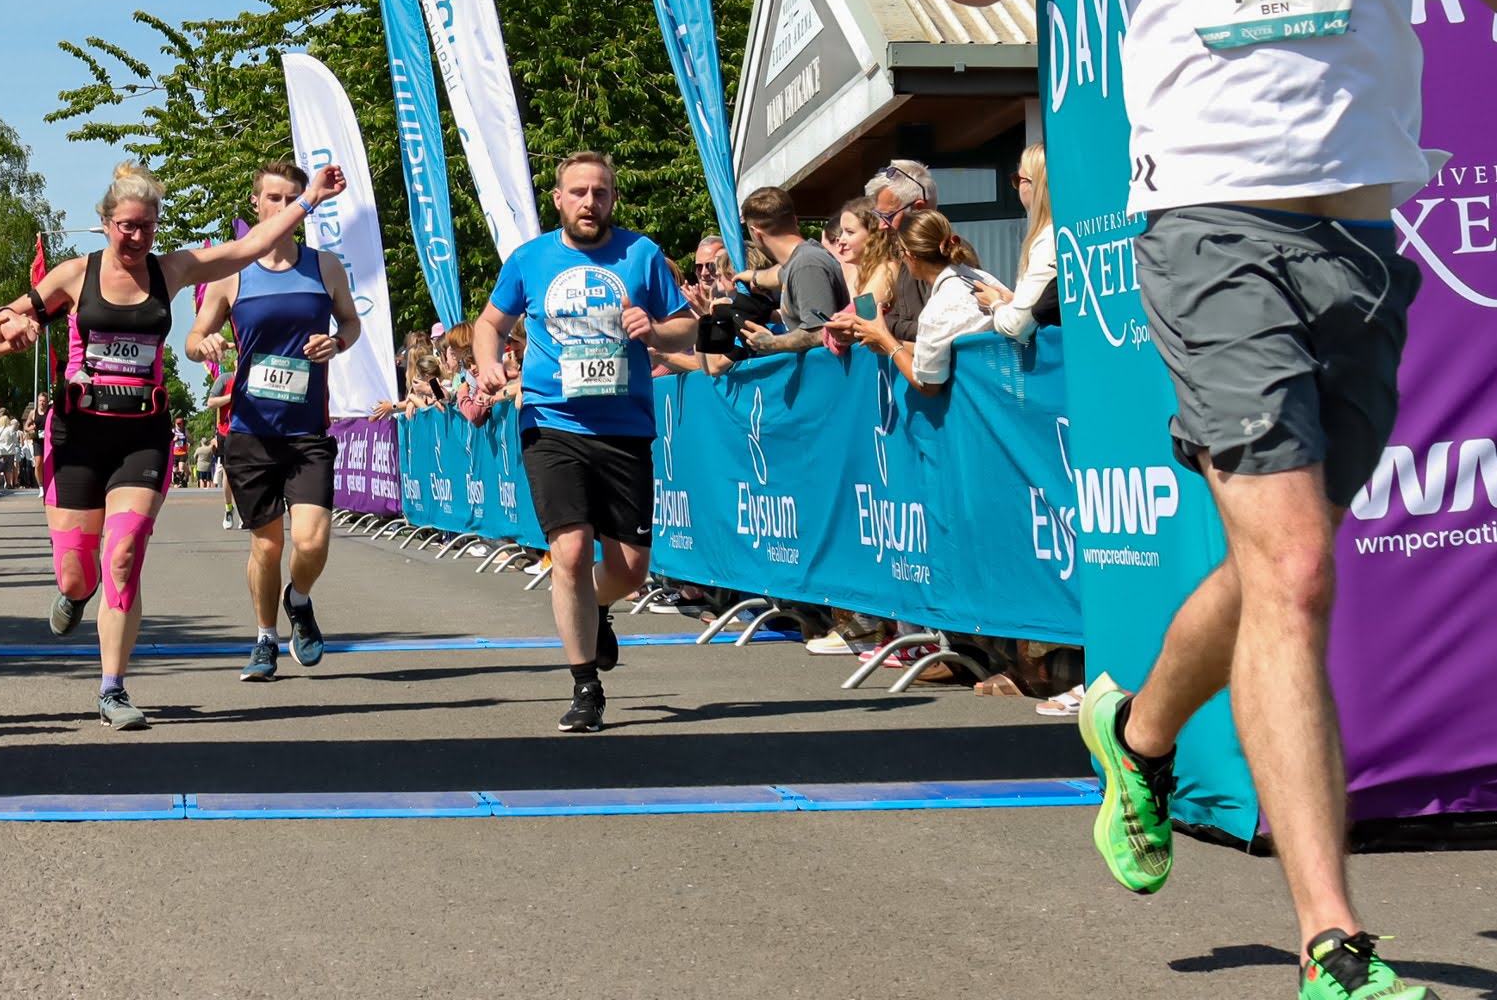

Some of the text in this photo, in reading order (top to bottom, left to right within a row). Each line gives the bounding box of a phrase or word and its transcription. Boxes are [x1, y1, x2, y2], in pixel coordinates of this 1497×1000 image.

[1261, 2, 1290, 15] BEN
[772, 10, 812, 67] EXETER ARENA
[1284, 20, 1316, 36] DAYS
[103, 342, 139, 357] 3260
[263, 368, 294, 385] 1617
[580, 360, 615, 378] 1628
[652, 479, 691, 537] Elysium
[1073, 466, 1179, 535] WMP
[737, 482, 798, 549] Elysium
[766, 542, 799, 565] Healthcare
[1083, 545, 1160, 570] wmpcreative.com
